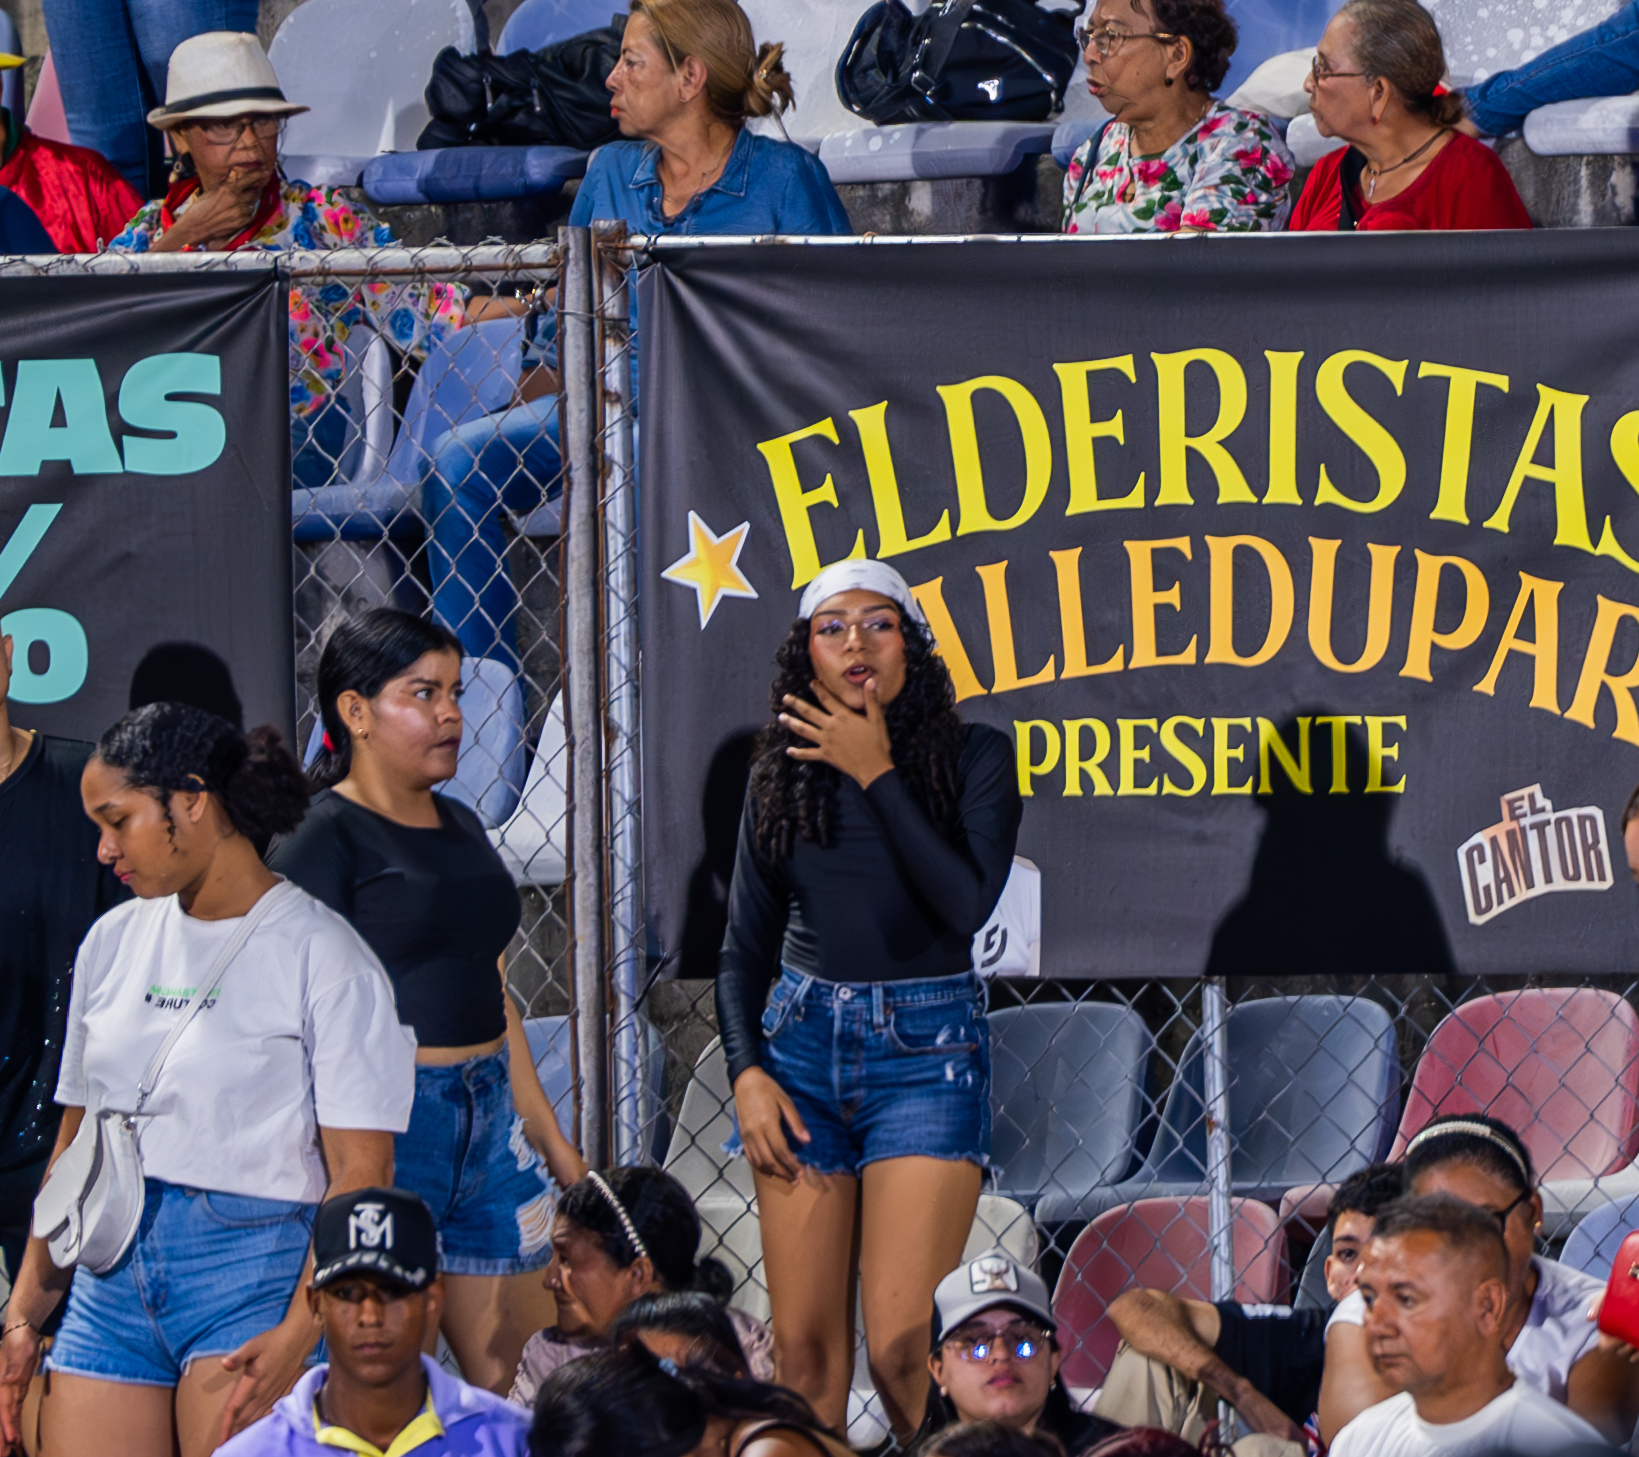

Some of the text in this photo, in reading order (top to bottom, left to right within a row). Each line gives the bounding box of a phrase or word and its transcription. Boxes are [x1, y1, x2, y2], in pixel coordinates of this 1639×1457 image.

[1014, 713, 1409, 797] PRESENTE
[1507, 792, 1545, 820] EL
[1464, 813, 1608, 917] CANTOR
